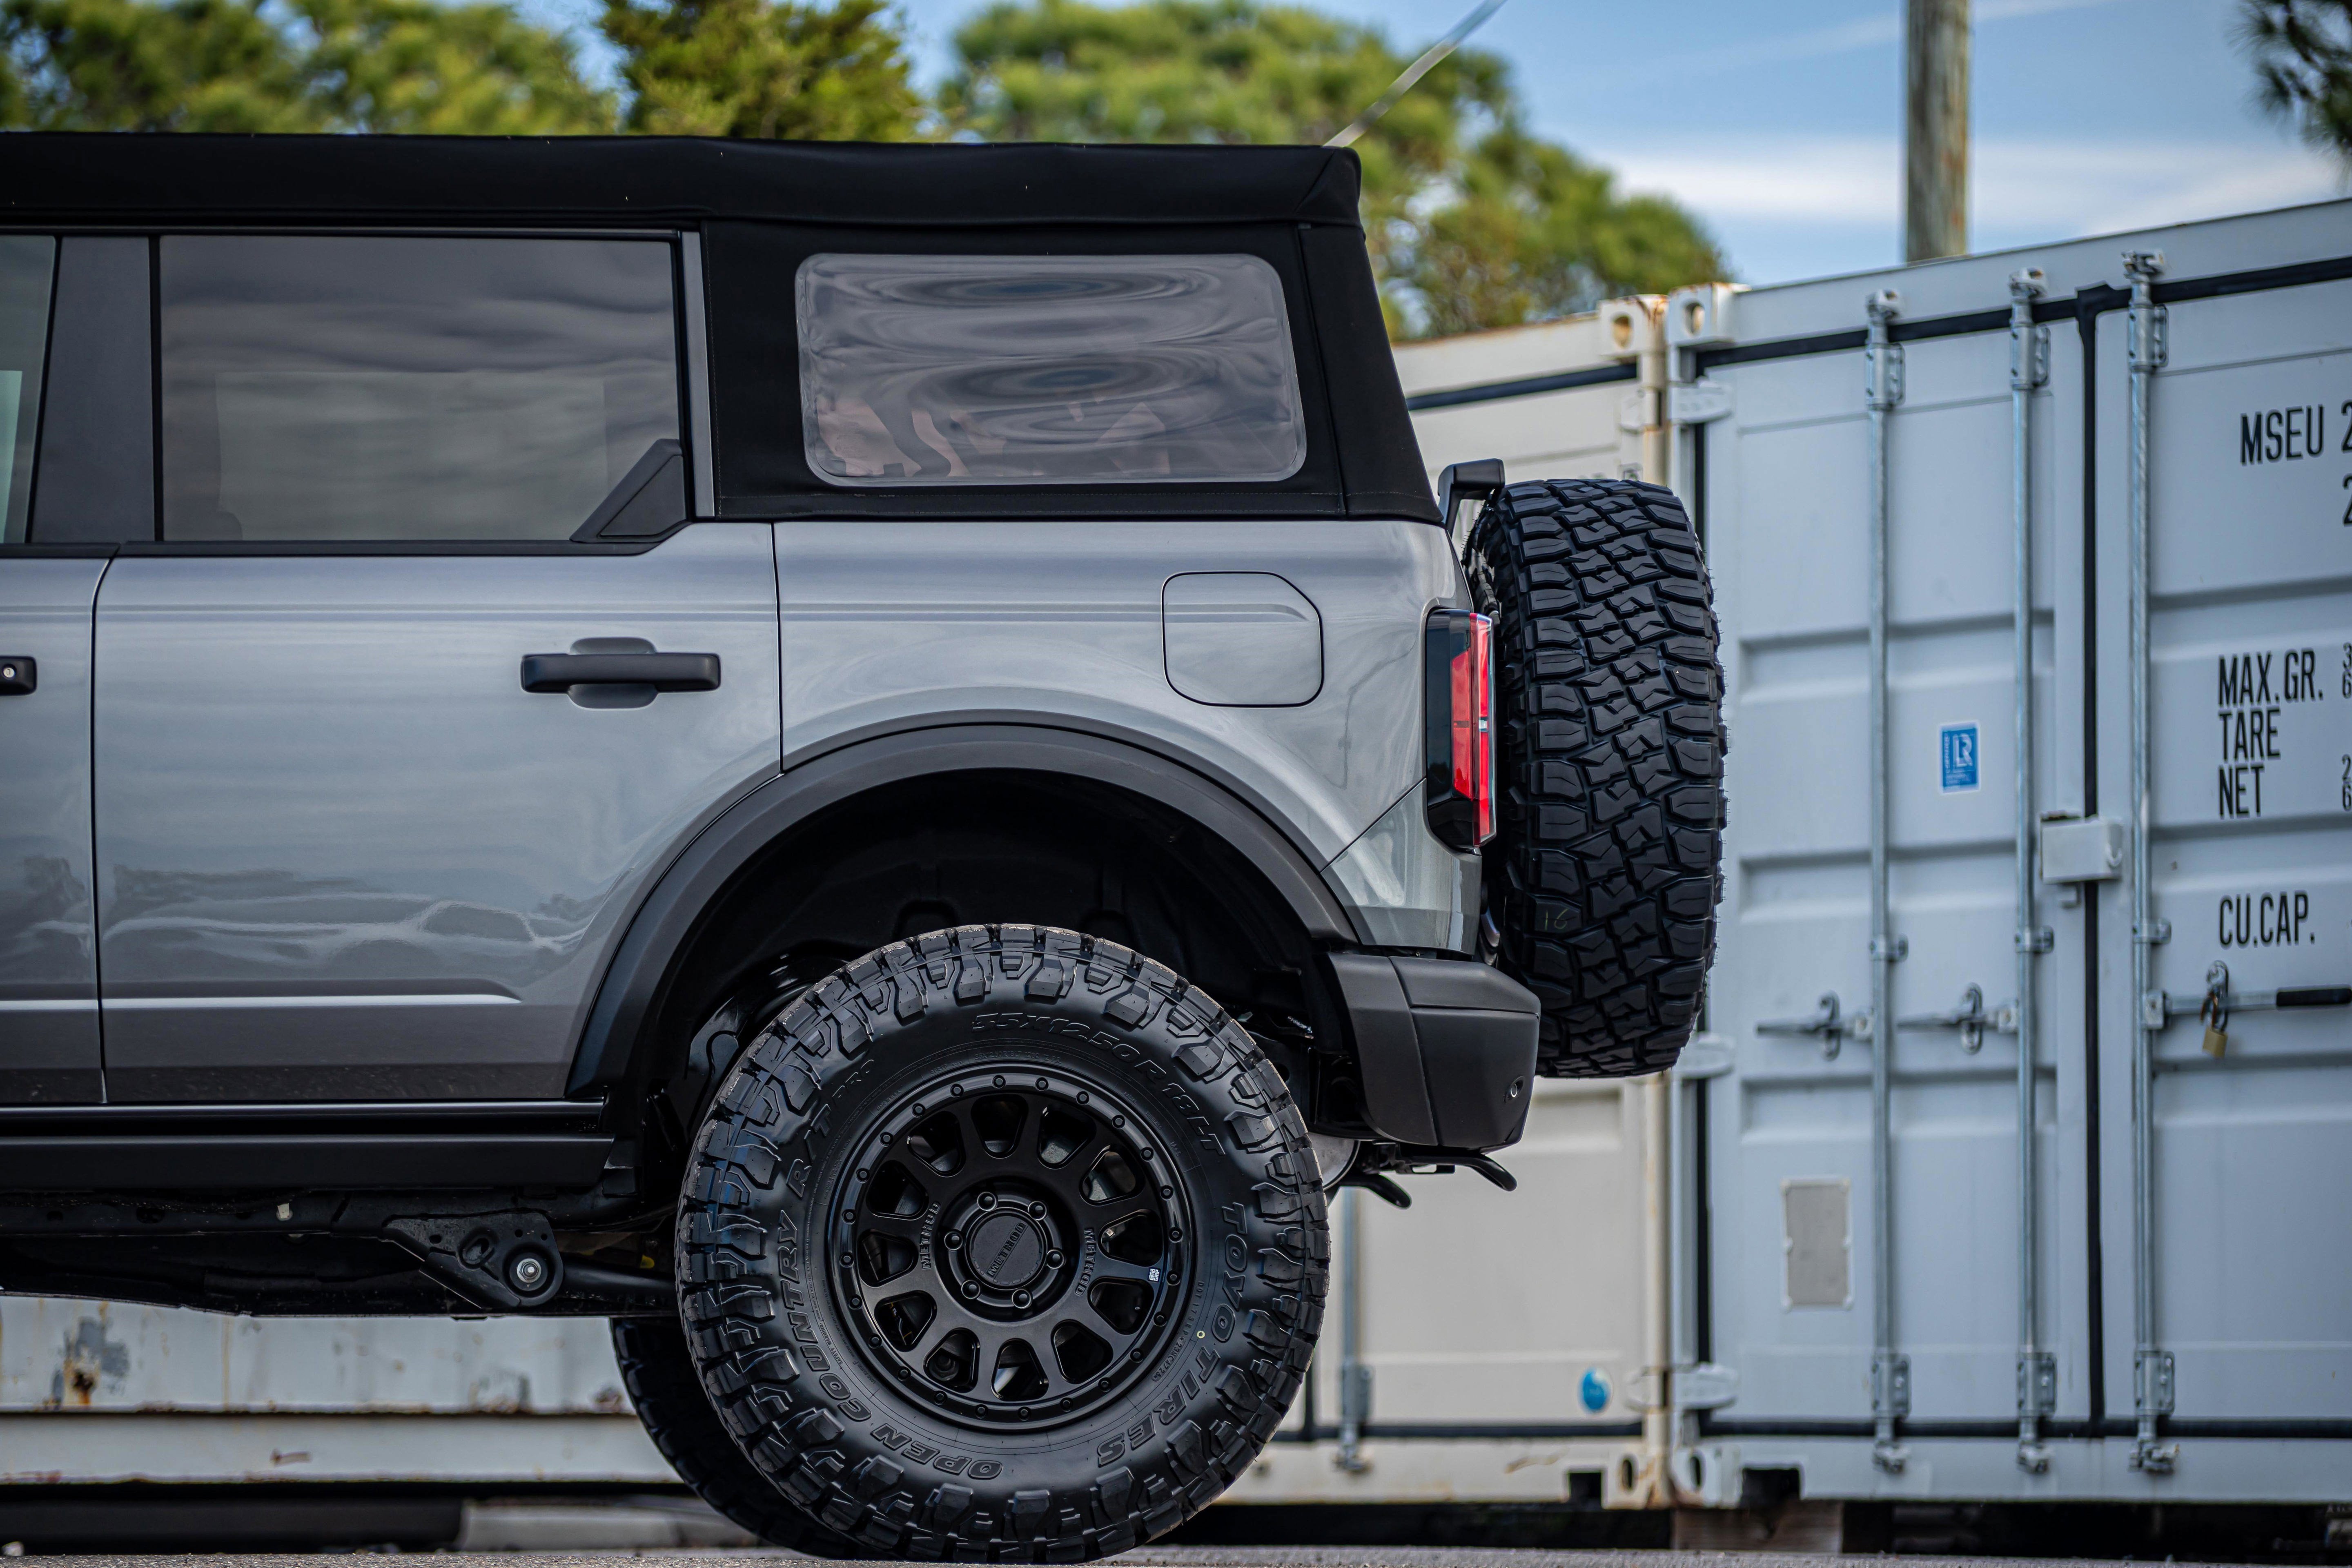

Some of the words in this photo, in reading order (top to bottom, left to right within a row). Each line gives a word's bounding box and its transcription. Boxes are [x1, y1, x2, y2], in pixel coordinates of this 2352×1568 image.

[2241, 404, 2325, 466] MSEU
[2218, 648, 2323, 708] MAX.GR.
[2218, 706, 2281, 763] TARE
[2218, 761, 2265, 820] NET
[2218, 889, 2315, 950] CU.CAP.
[920, 1202, 940, 1270] METHOD
[986, 1221, 1027, 1278] METHOD
[1075, 1227, 1097, 1296] METHOD
[1195, 1281, 1204, 1298] DOT
[1212, 1202, 1247, 1343] TOYO
[777, 1210, 872, 1422] COUNTRY
[830, 1348, 844, 1365] SAFETY
[1097, 1346, 1221, 1468] TIRES
[870, 1422, 1004, 1480] OPEN
